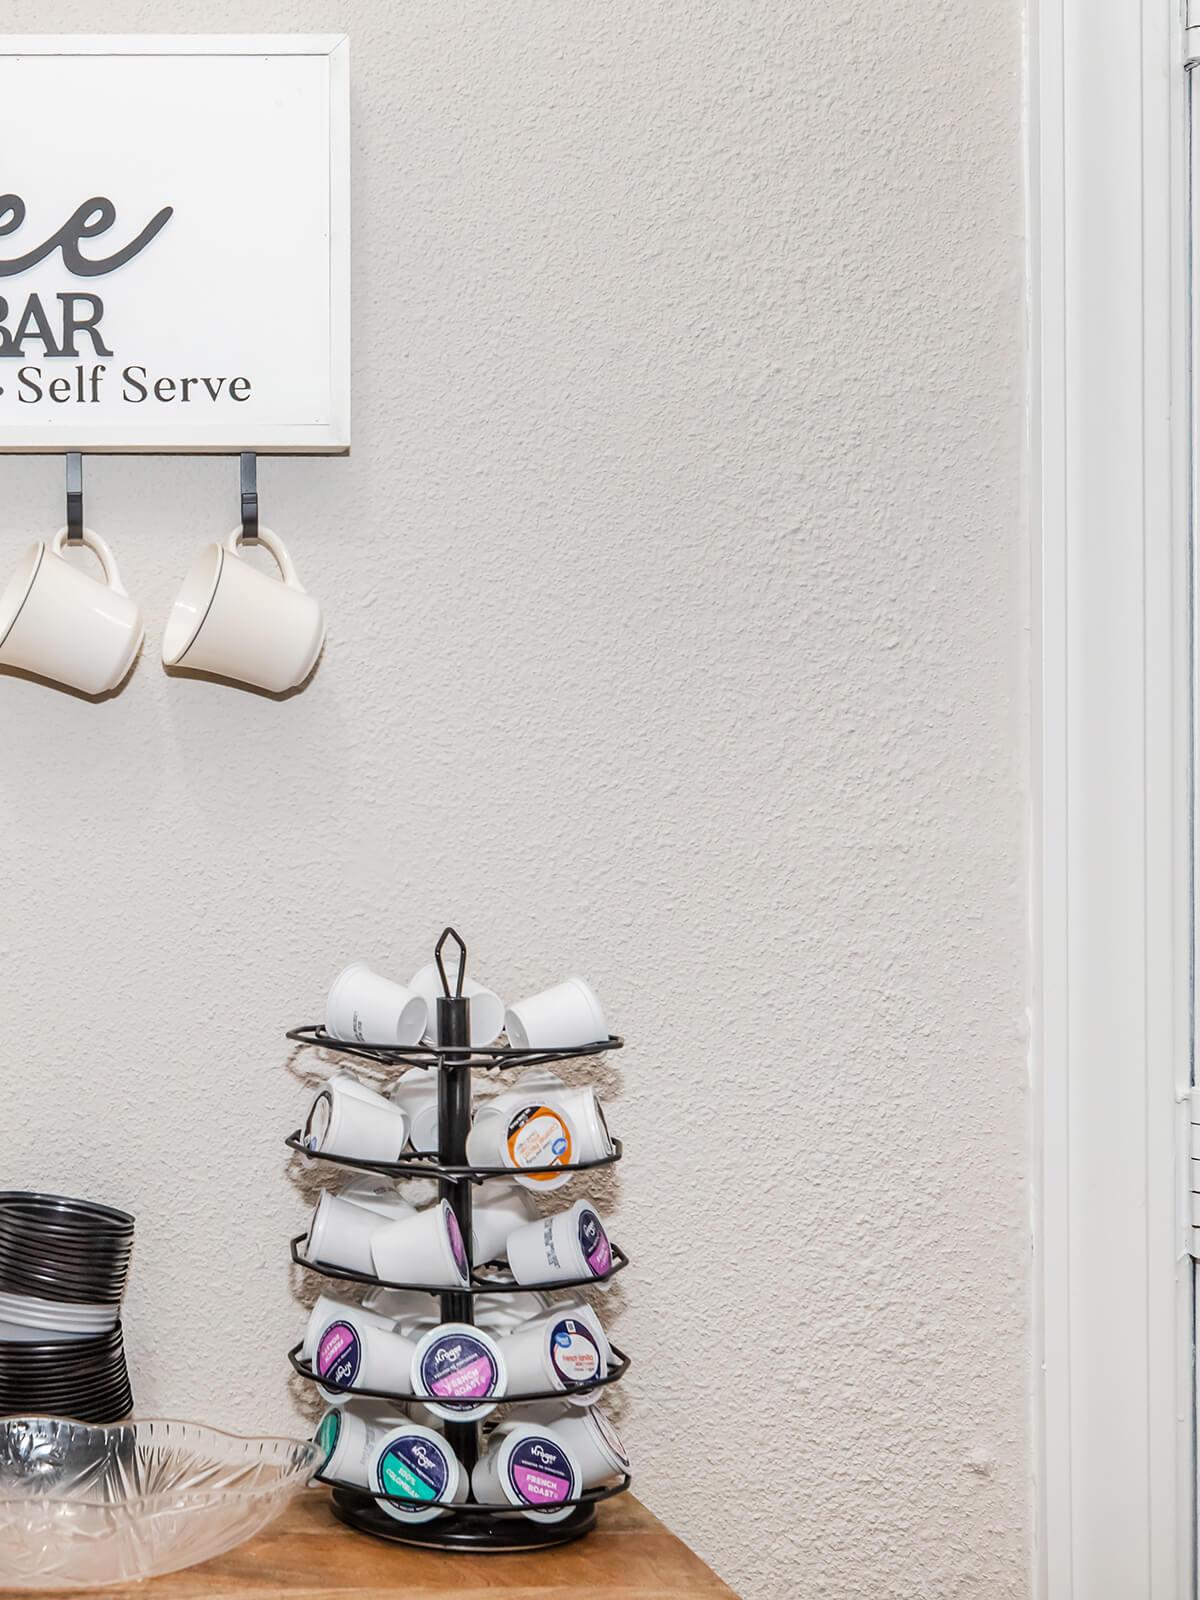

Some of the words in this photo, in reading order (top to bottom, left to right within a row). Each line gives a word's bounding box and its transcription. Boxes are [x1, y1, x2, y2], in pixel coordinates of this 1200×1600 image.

[18, 365, 106, 404] Self
[123, 366, 251, 404] Serve
[411, 1445, 436, 1469] Kroger
[531, 1445, 557, 1464] Kroger
[526, 1474, 557, 1489] FRENCH
